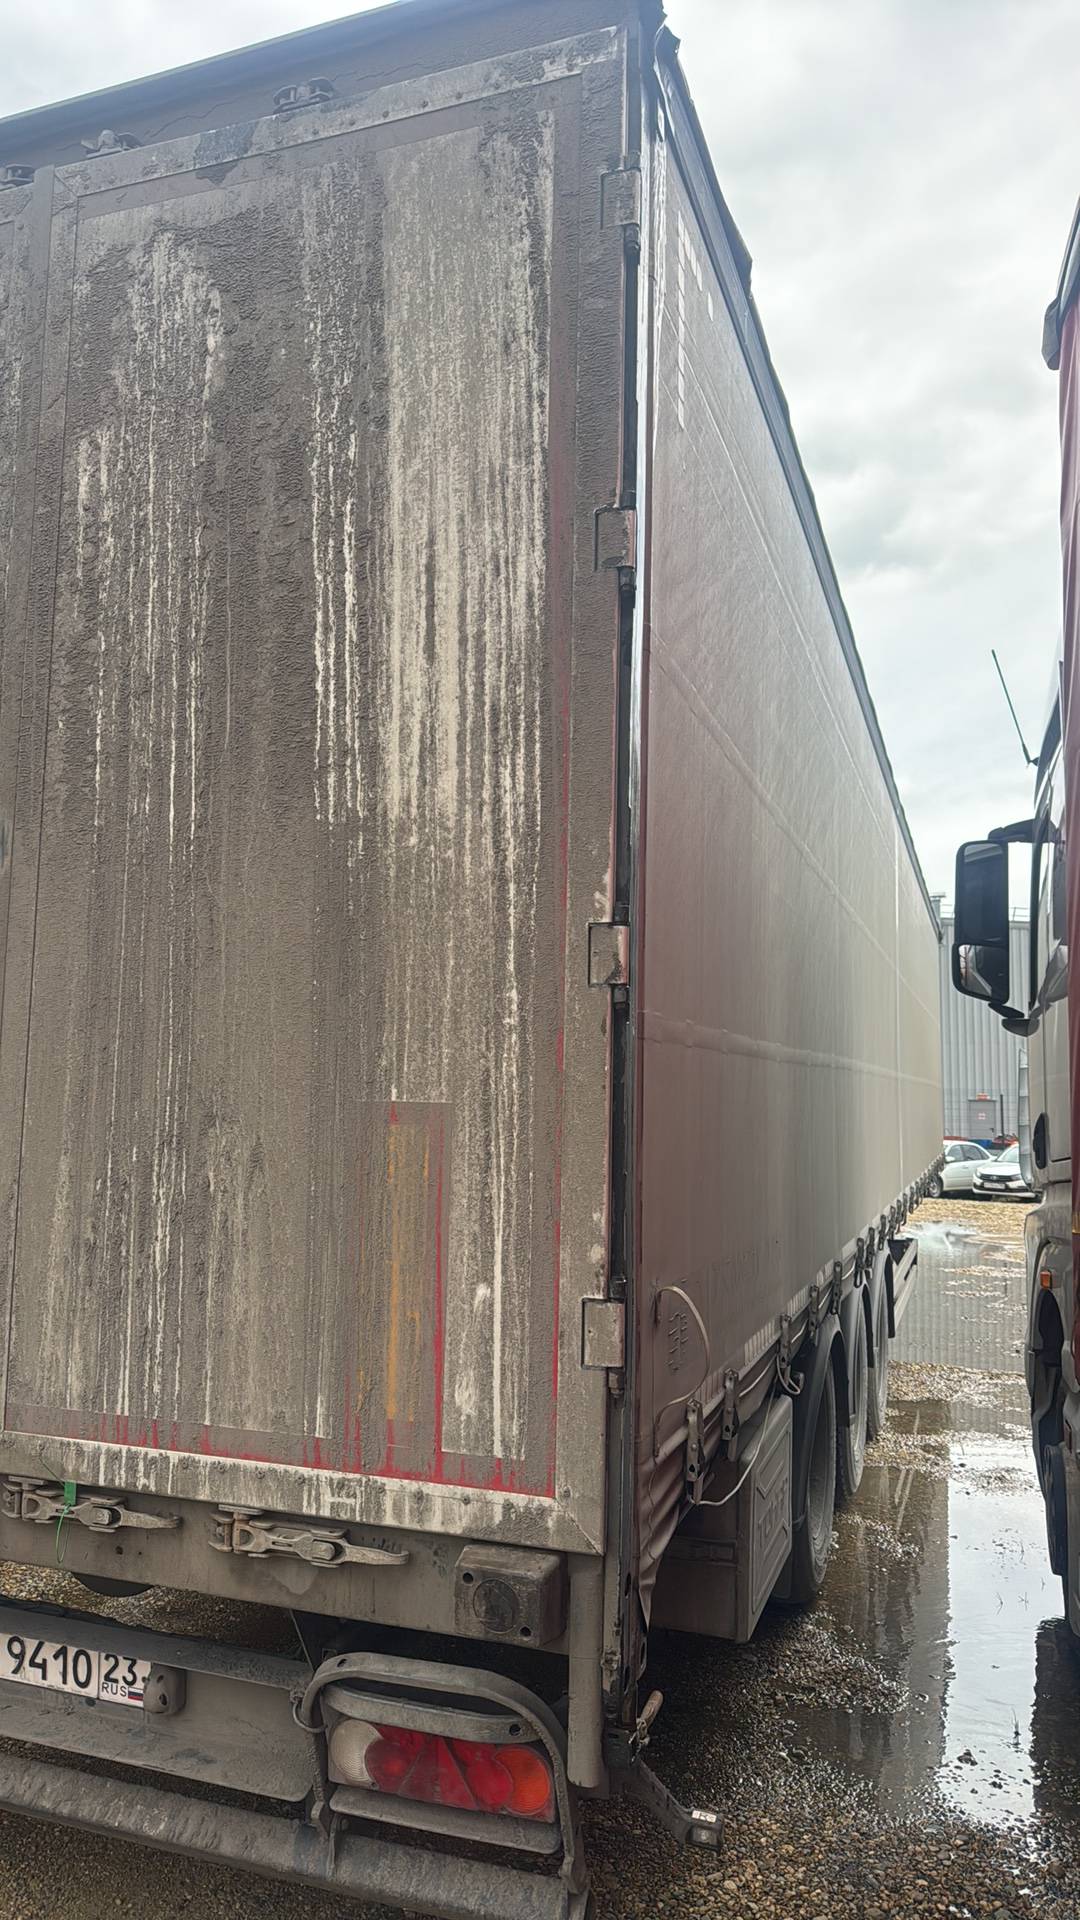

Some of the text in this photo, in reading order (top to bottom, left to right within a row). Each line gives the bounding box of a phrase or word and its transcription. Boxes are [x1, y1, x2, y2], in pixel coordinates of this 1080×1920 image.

[7, 1635, 138, 1689] 9410 23
[101, 1681, 128, 1698] RUS
